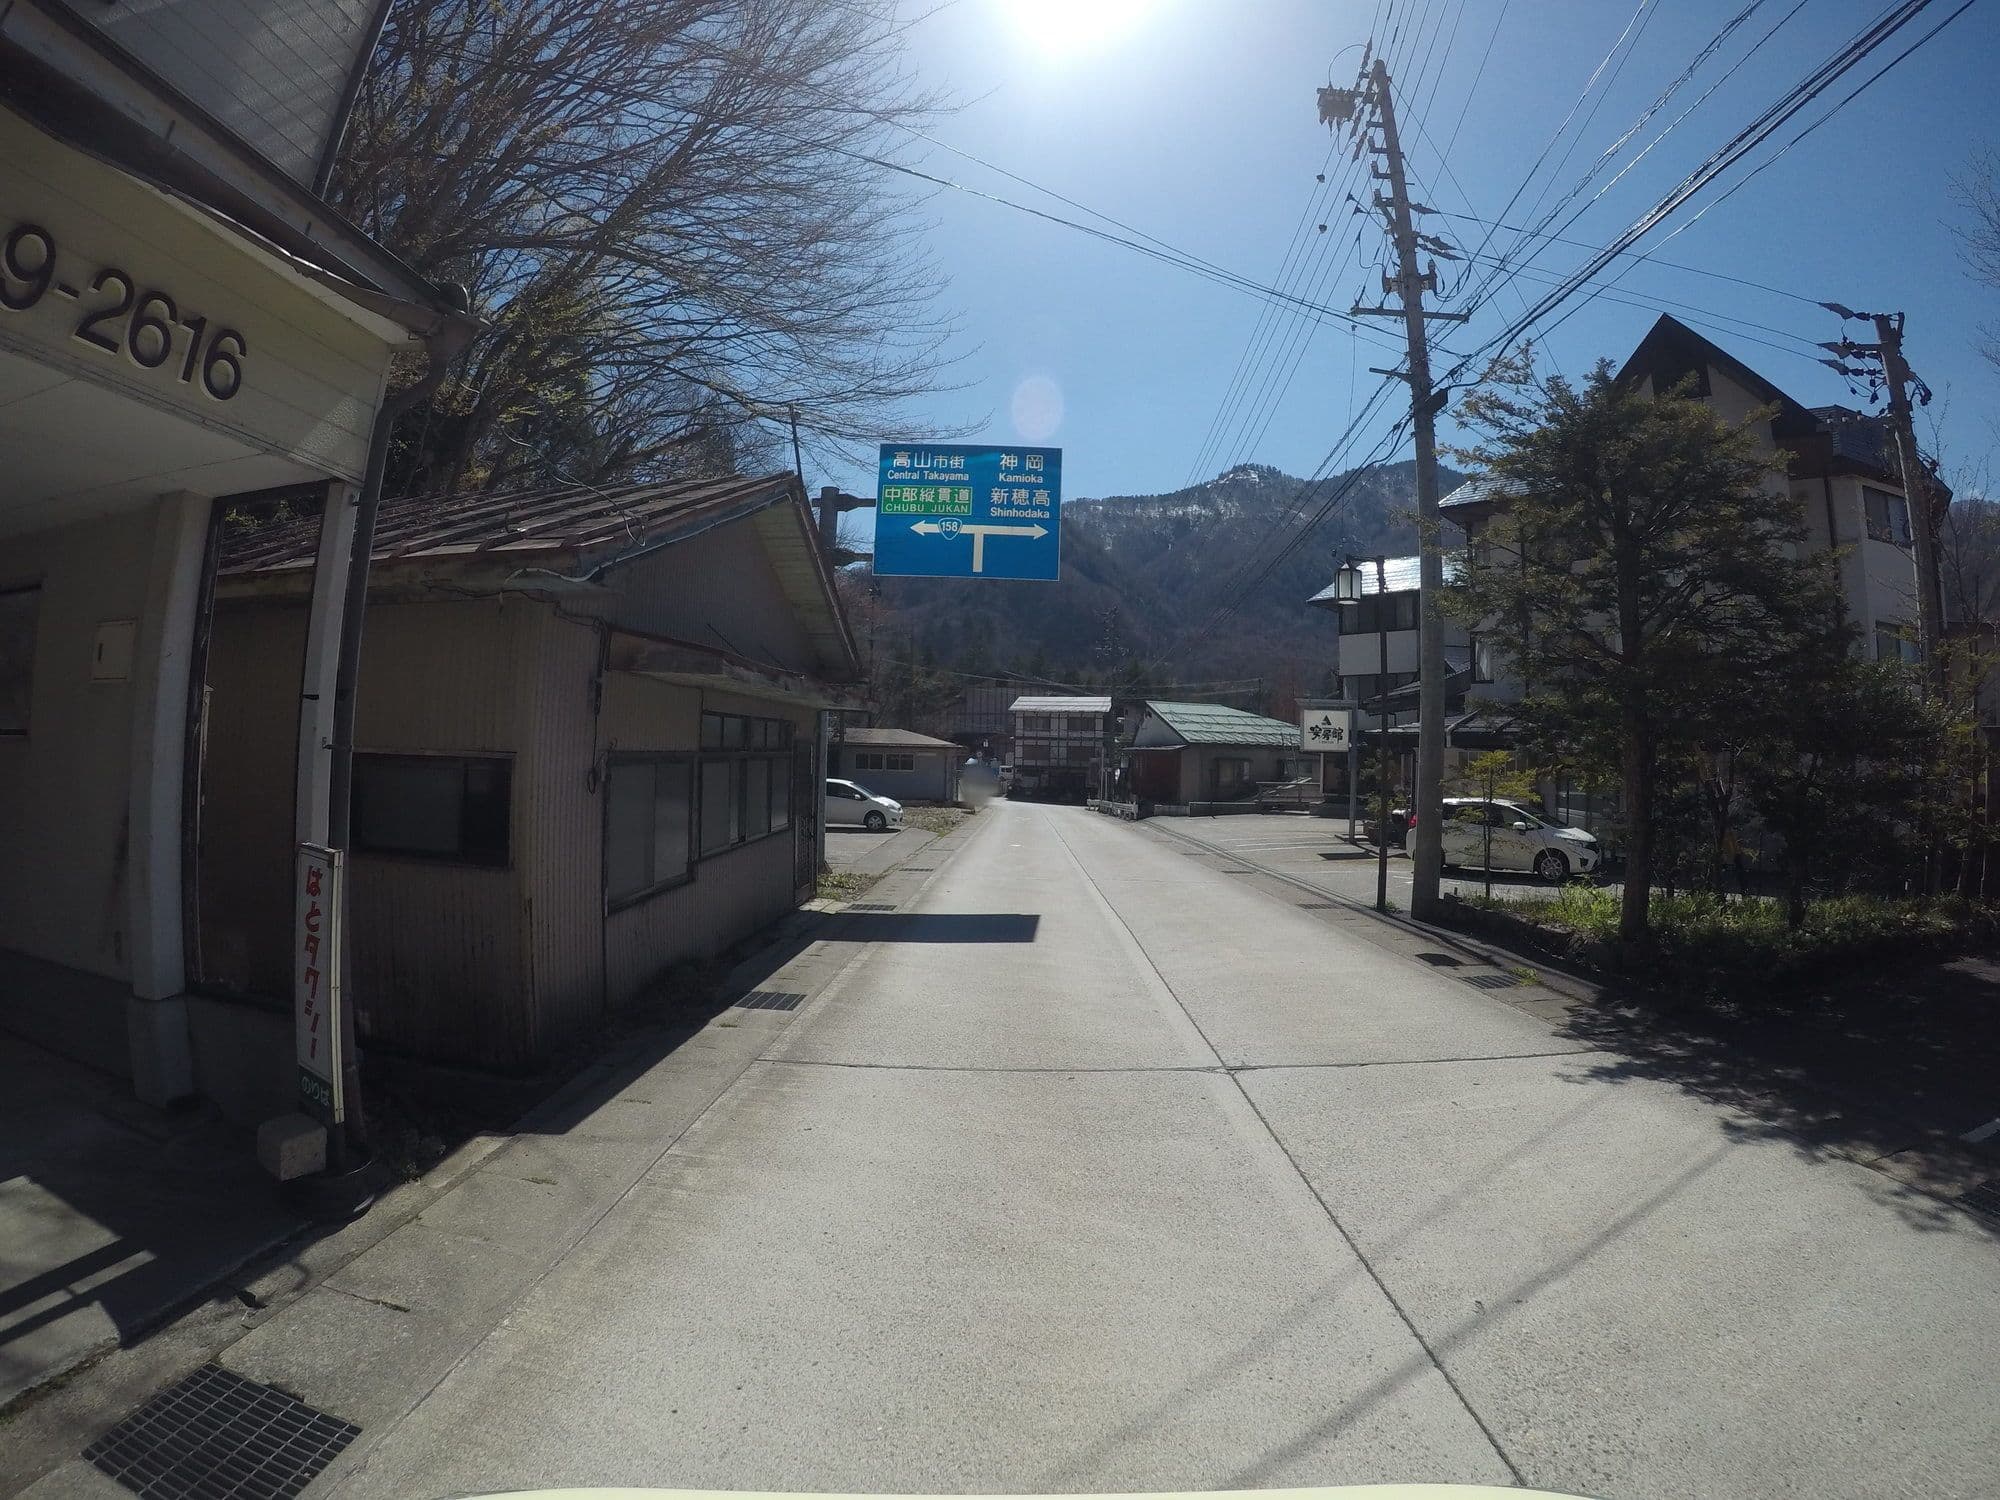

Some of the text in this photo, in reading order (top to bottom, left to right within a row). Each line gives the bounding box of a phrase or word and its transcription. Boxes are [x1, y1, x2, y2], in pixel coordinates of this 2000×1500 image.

[0, 223, 247, 401] 9-2616
[893, 451, 965, 469] 高山市街
[1000, 453, 1044, 472] 神岡
[887, 470, 969, 482] Central Takayama
[999, 473, 1043, 484] Kamioka
[884, 487, 970, 504] 中部縦貫道
[991, 487, 1051, 507] 新穂高
[885, 503, 968, 514] CHUBU JUKAN
[990, 507, 1050, 519] Shinhodaka
[941, 522, 958, 533] 158
